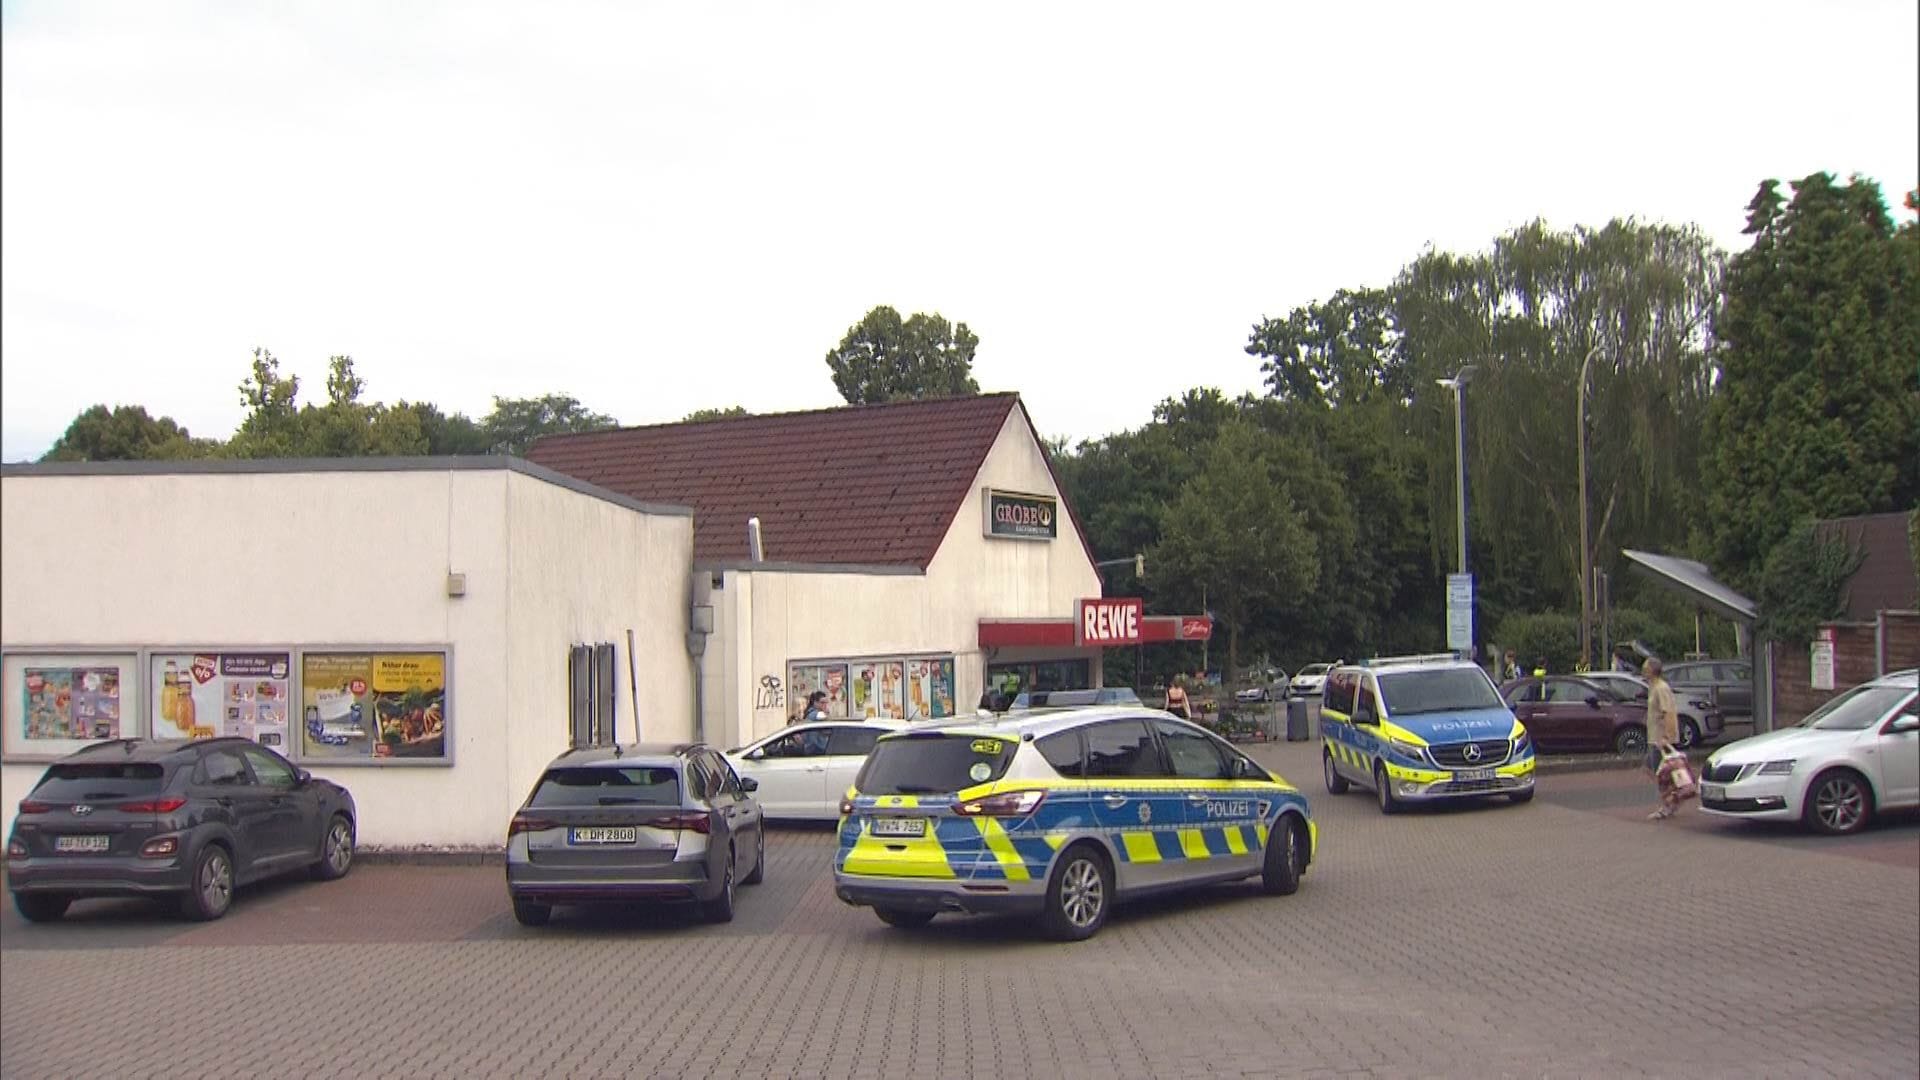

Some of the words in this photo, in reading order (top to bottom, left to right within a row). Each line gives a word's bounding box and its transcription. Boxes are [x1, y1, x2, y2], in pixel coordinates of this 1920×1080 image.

[1084, 605, 1138, 640] REWE
[1432, 719, 1492, 731] POLIZEI
[1207, 800, 1249, 818] POLIZEI
[575, 828, 582, 840] K
